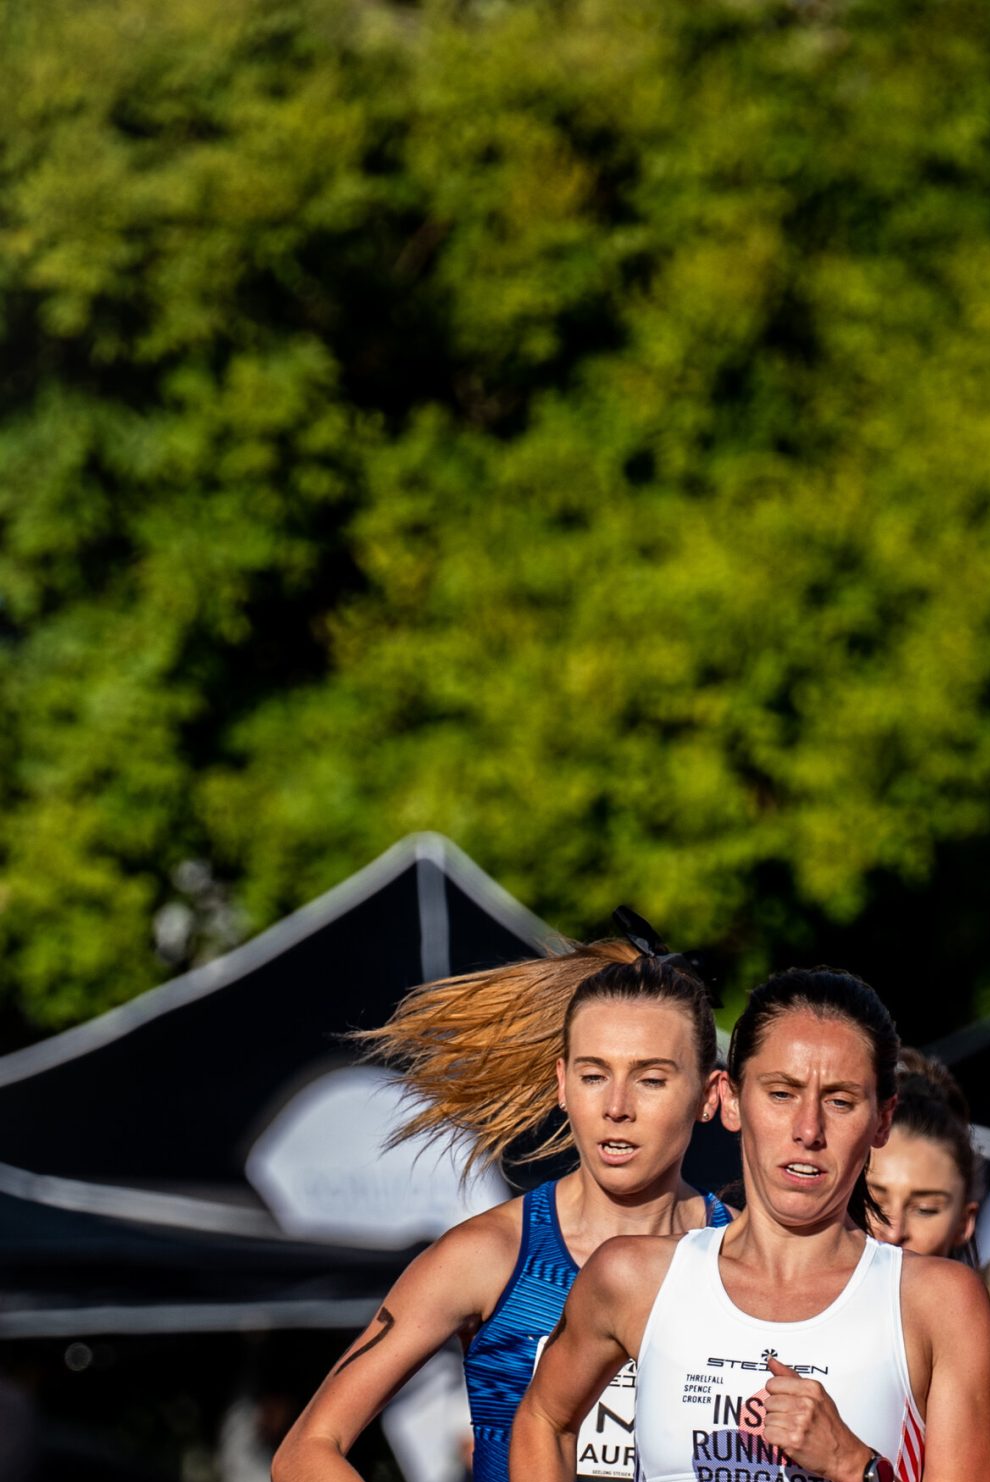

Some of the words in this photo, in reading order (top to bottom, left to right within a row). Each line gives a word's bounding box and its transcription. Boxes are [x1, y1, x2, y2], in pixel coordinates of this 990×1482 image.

[706, 1357, 828, 1375] STEIEN
[686, 1373, 724, 1385] THRELFALL
[684, 1384, 712, 1394] SPENCE
[682, 1395, 712, 1404] CROKER
[713, 1394, 764, 1428] INS
[579, 1443, 635, 1466] AUR
